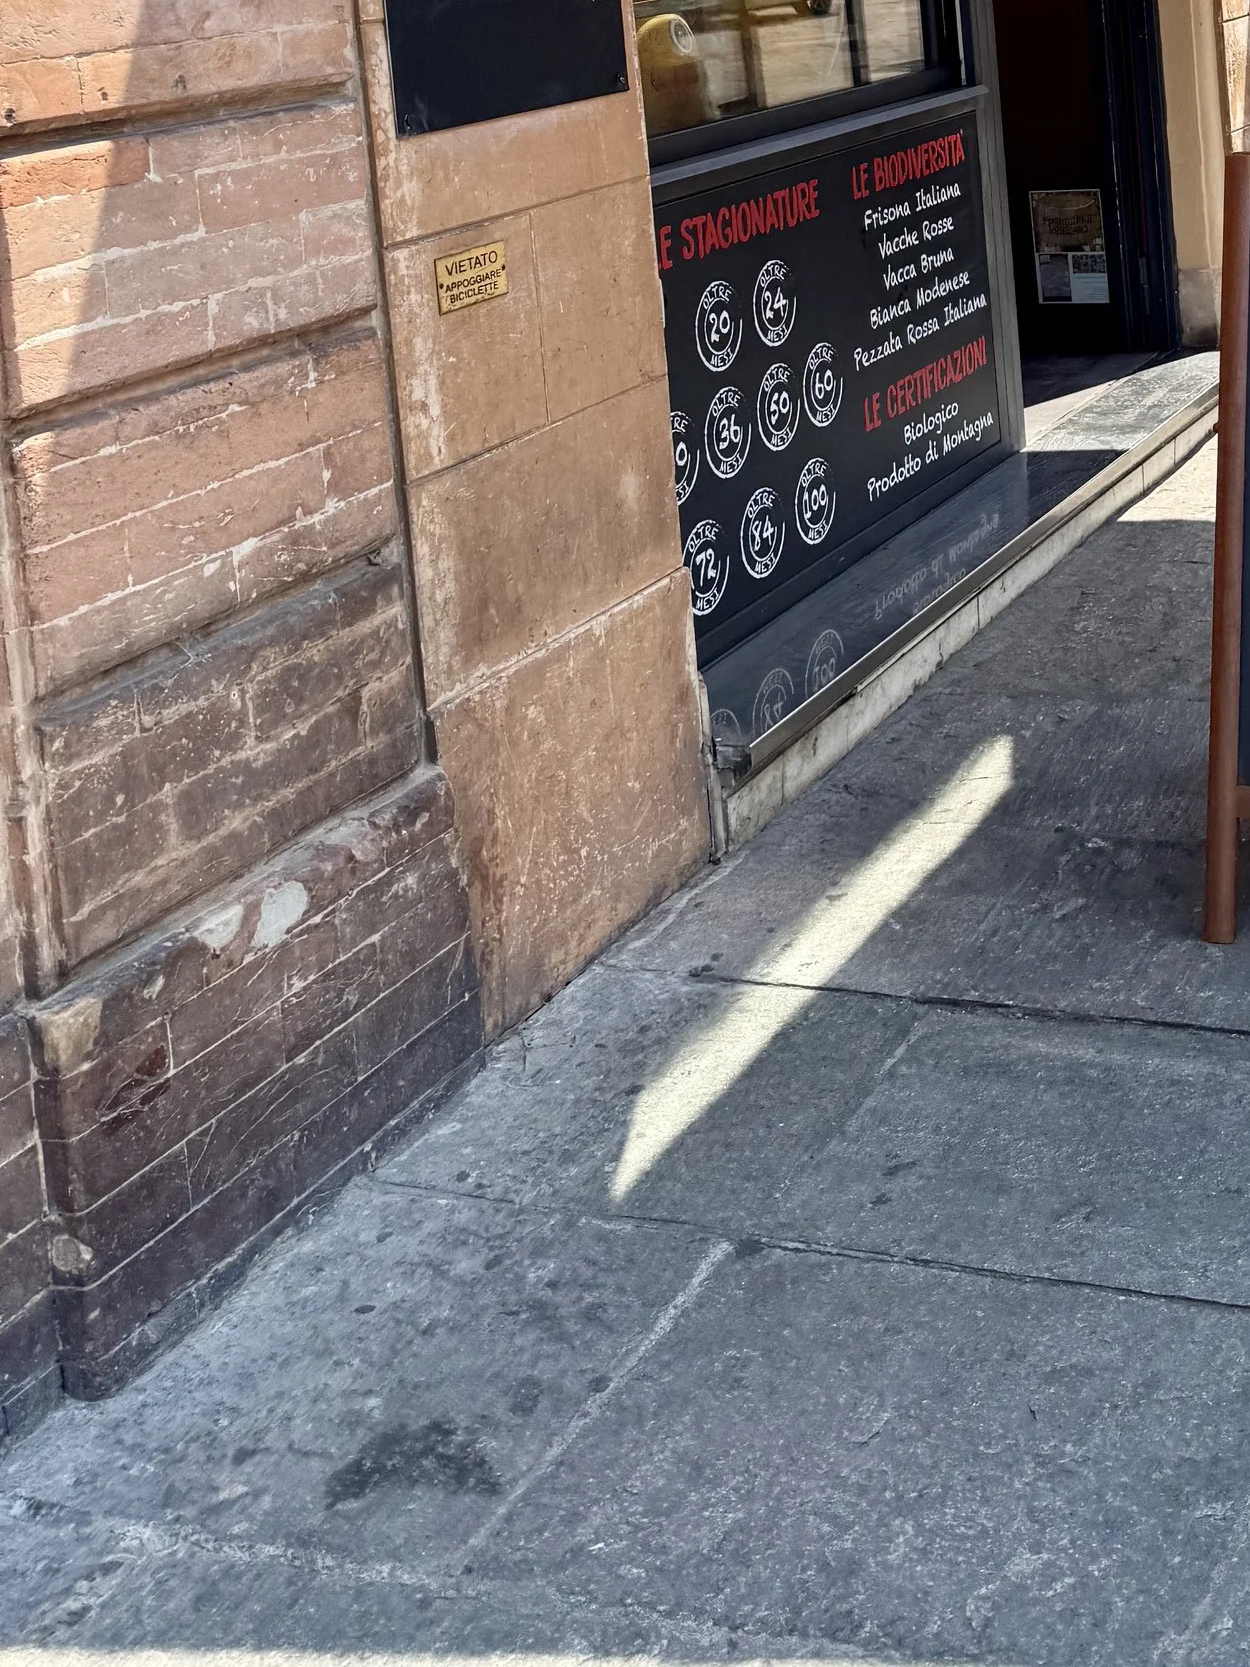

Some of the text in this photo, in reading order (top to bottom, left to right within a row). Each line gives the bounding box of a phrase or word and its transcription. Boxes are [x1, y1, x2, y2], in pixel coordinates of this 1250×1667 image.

[851, 162, 869, 201] LE
[864, 182, 962, 231] Frisona Italiana
[658, 179, 821, 271] E STAGIONATURE
[878, 215, 955, 260] Vacche Rosse
[445, 250, 498, 276] VIETATO
[759, 264, 787, 288] OLTRE
[882, 246, 955, 291] Vacca Bruna
[445, 268, 502, 294] APPOGGIARE
[449, 281, 499, 304] BICICLETTE
[703, 285, 732, 310] OLTRE
[765, 287, 787, 319] 24
[869, 269, 970, 331] Bianca Modenese
[709, 309, 731, 343] 20
[767, 325, 788, 342] MESI
[853, 292, 988, 372] Pezzata Rossa Italiana
[710, 349, 733, 367] MESI
[809, 347, 834, 370] OLTRE
[764, 367, 791, 392] OLTRE
[815, 369, 833, 399] 60
[863, 335, 988, 433] LE CERTIFICAZIONI
[712, 389, 741, 417] OLTRE
[770, 390, 790, 425] 50
[816, 405, 836, 422] MESI
[719, 413, 741, 450] 36
[771, 428, 793, 446] MESI
[903, 401, 960, 446] Biologico
[720, 456, 743, 474] MESI
[867, 411, 995, 503] Prodotto di Montagna
[801, 462, 827, 487] OLTRE
[748, 492, 775, 519] OLTRE
[803, 484, 827, 519] 100
[688, 525, 719, 553] OLTRE
[752, 515, 774, 552] 84
[808, 519, 828, 539] MESI
[695, 548, 717, 587] 72
[755, 552, 776, 574] MESI
[696, 588, 720, 610] MESI
